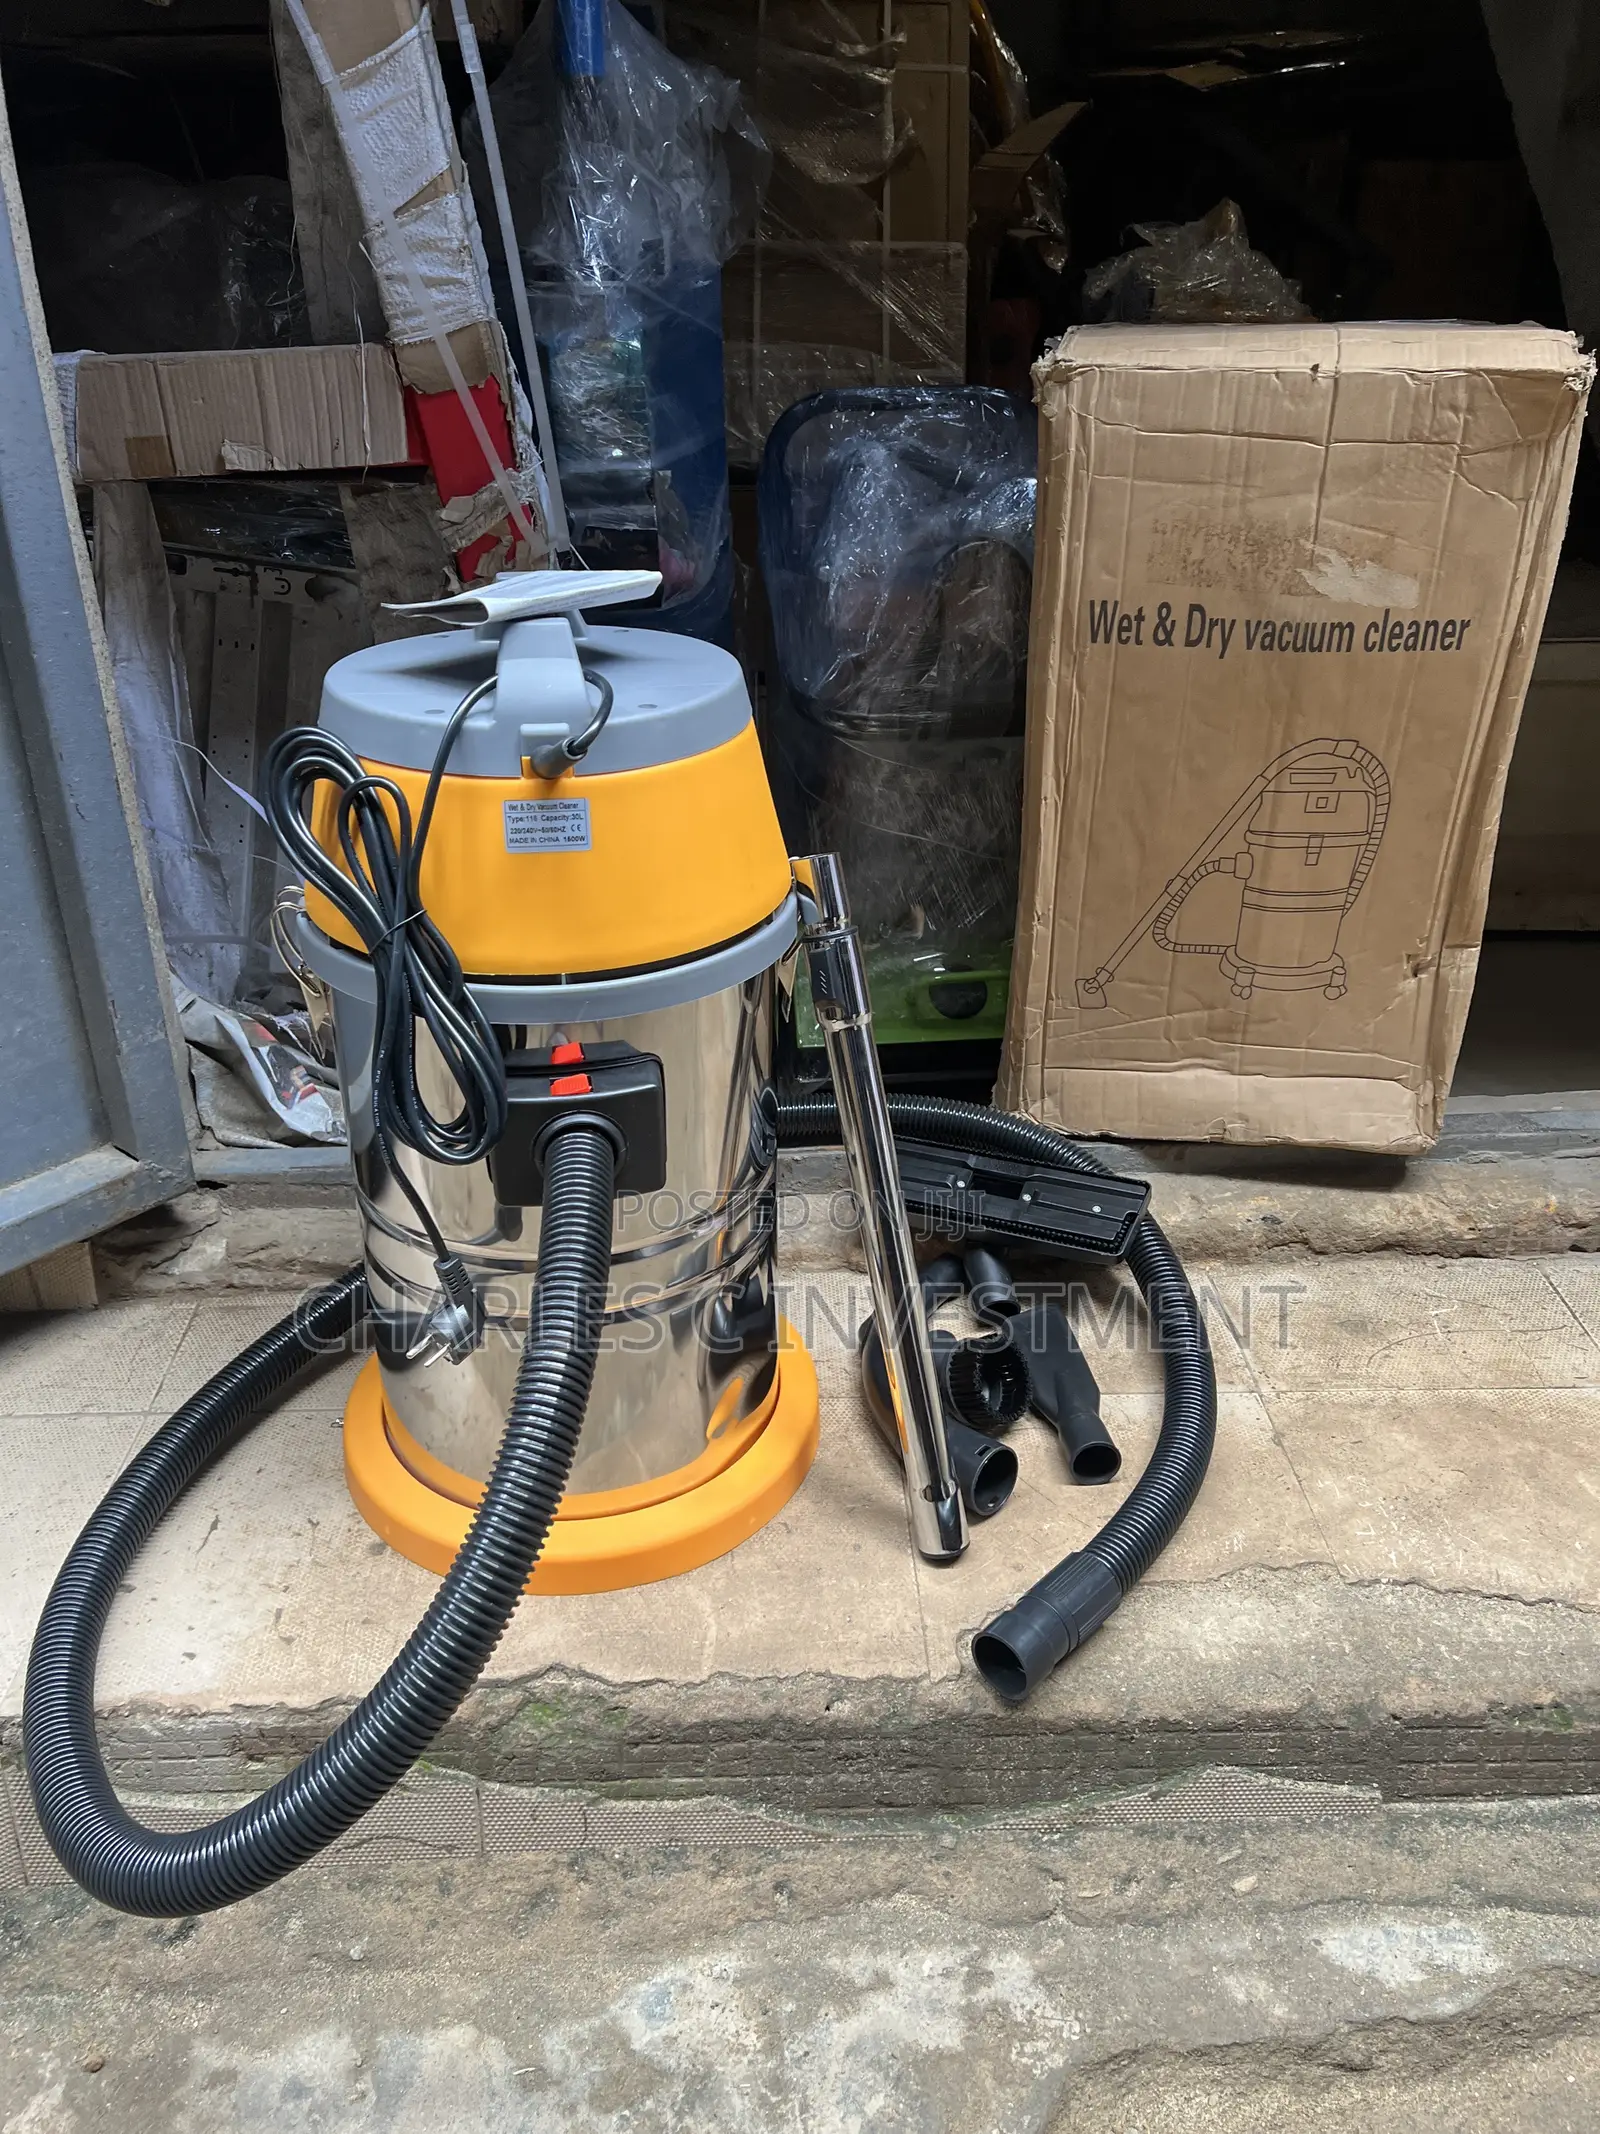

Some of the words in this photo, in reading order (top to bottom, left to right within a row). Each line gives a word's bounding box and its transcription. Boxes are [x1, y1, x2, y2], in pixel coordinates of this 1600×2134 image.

[1089, 600, 1146, 645] Wet
[1152, 602, 1177, 647] &
[1184, 604, 1237, 659] Dry
[1244, 619, 1356, 653] vacuum
[1364, 608, 1471, 652] cleaner
[527, 803, 536, 812] Dry
[539, 836, 560, 844] CHINA
